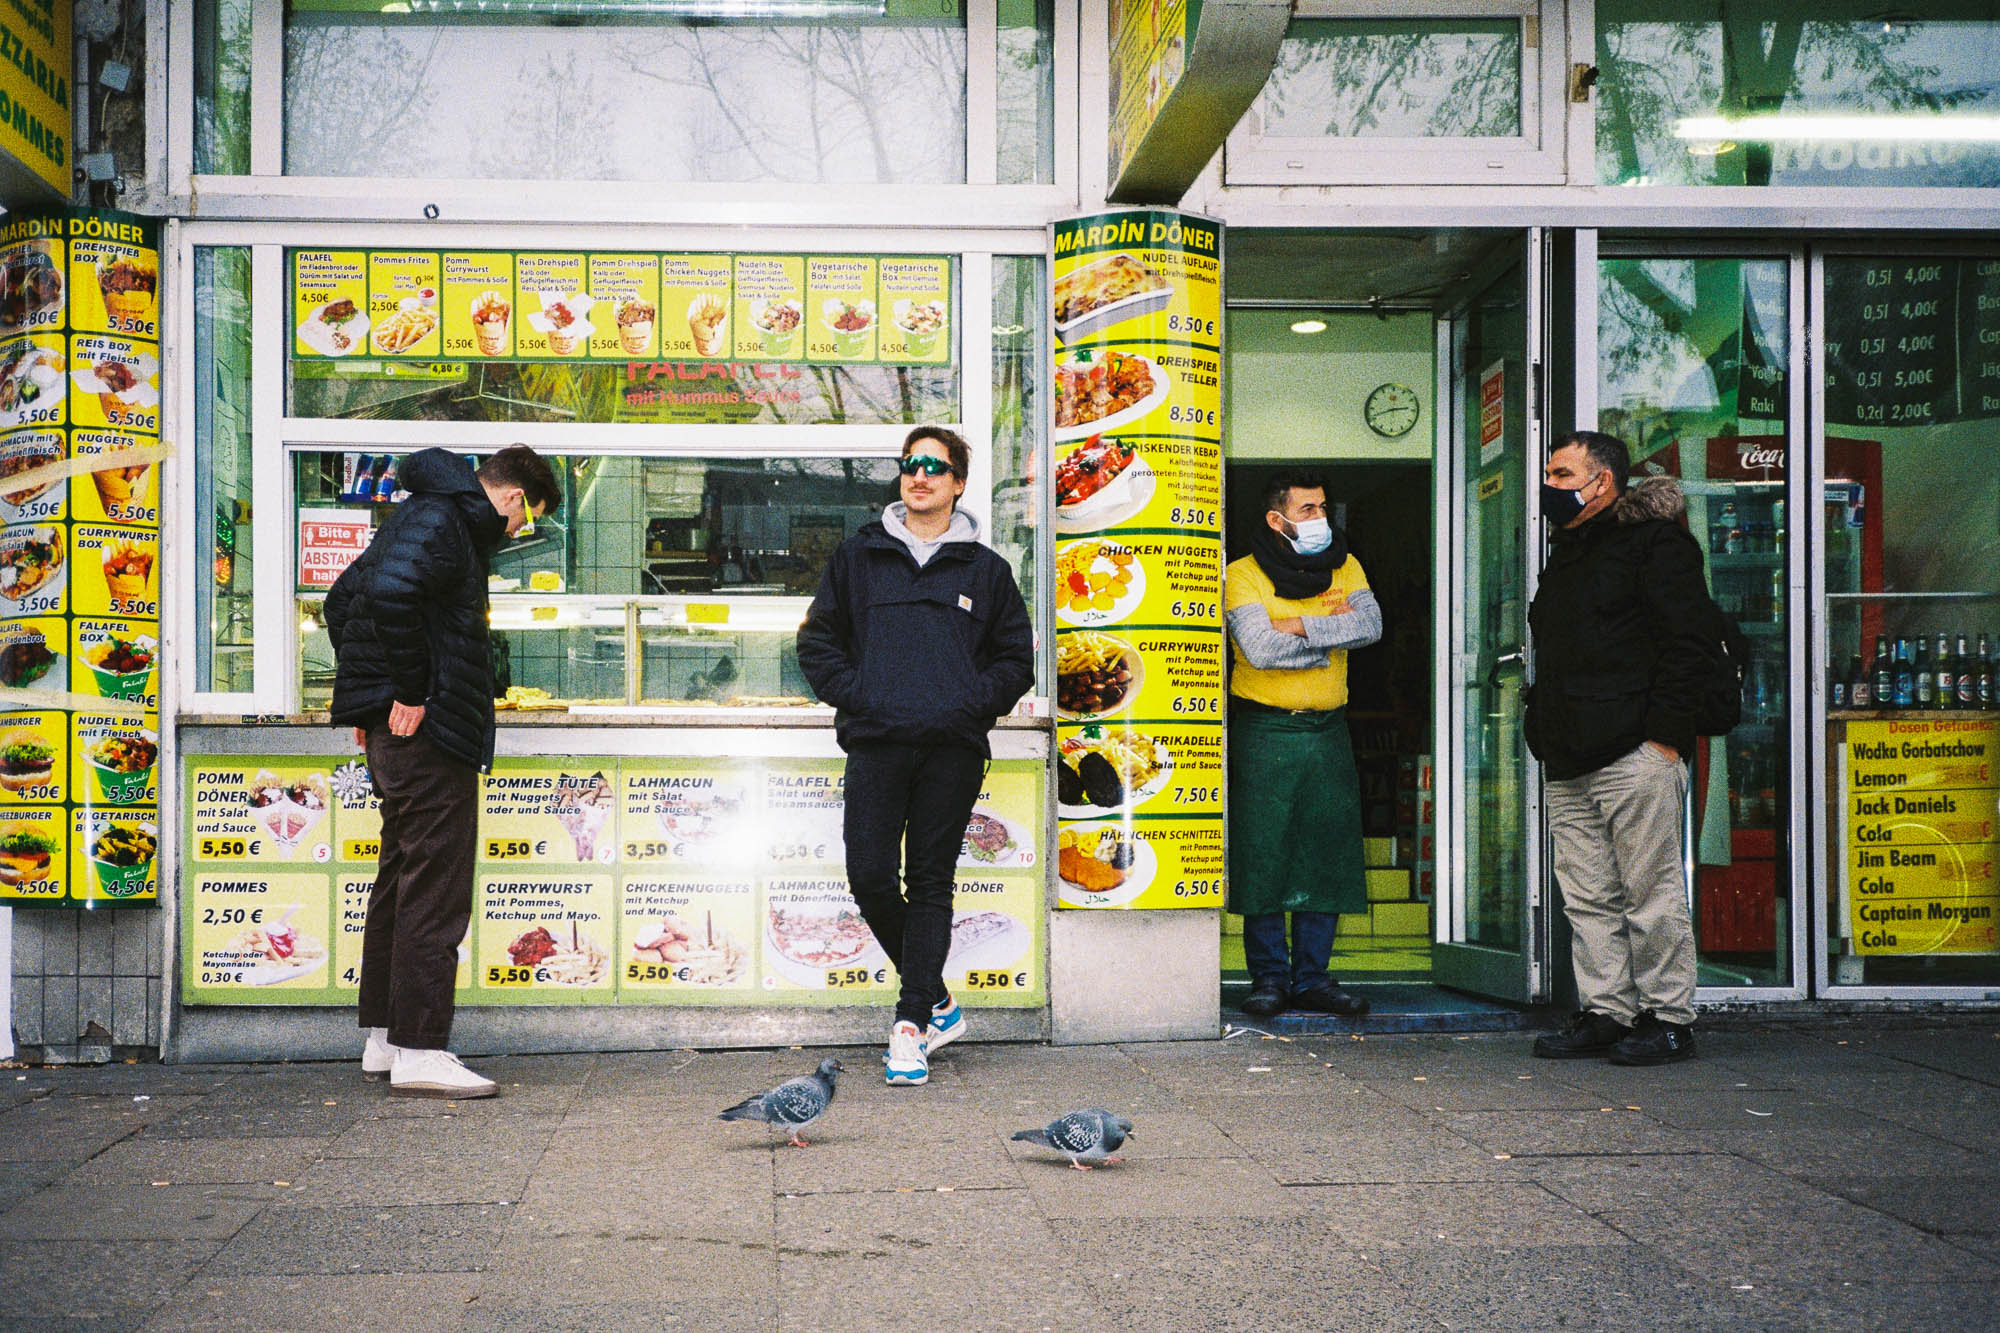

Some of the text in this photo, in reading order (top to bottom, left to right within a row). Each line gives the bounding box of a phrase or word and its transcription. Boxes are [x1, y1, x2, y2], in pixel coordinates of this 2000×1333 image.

[69, 216, 144, 245] DÖNER
[1151, 220, 1215, 251] DÖNER
[73, 253, 100, 265] BOX
[299, 253, 333, 262] FALAFEL
[373, 256, 430, 265] Pommes Frites
[445, 256, 470, 265] Pomm
[519, 258, 579, 268] Reis Drehspieß
[591, 259, 657, 269] Pomm Drehspieß
[665, 259, 690, 268] Pomm
[1142, 252, 1218, 272] NUDEL AUFLAUF
[445, 265, 489, 274] Currywurst
[738, 260, 783, 269] Nudeln Box
[811, 262, 868, 272] Vegetarische
[882, 263, 939, 273] Vegetarische
[664, 267, 730, 278] Chicken Nuggets
[811, 272, 828, 280] Box
[882, 273, 898, 281] Box
[1904, 265, 1942, 285] 4,00€
[299, 281, 337, 289] Sesamsauce
[301, 293, 329, 303] 4,50€
[371, 301, 399, 312] 2,50€
[1901, 300, 1939, 320] 4,00€
[107, 315, 155, 336] 5,50€
[1168, 314, 1203, 334] 8,50
[76, 338, 132, 353] REIS BOX
[446, 339, 473, 350] 5,50€
[519, 339, 547, 350] 5,50€
[591, 339, 619, 350] 5,50€
[664, 340, 691, 351] 5,50€
[737, 342, 765, 353] 5,50€
[811, 343, 838, 353] 4,50€
[881, 343, 908, 353] 4,50€
[1898, 334, 1936, 354] 4,00€
[76, 351, 141, 367] mit Fleisch
[1180, 371, 1218, 388] TELLER
[1895, 368, 1934, 388] 5,00€
[627, 391, 655, 406] mit
[1751, 397, 1775, 413] Raki
[18, 408, 59, 427] 5,50€
[1169, 406, 1203, 425] 8,50
[1891, 402, 1932, 421] 2,00€
[107, 410, 156, 430] 5,50€
[77, 433, 134, 448] NUGGETS
[77, 445, 102, 455] BOX
[1139, 442, 1218, 460] ISKENDER KEBAP
[18, 502, 59, 518] 5,50€
[108, 503, 156, 522] 5,50€
[1170, 507, 1204, 525] 8,50
[77, 527, 157, 543] CURRYWURST
[318, 527, 351, 539] Bitte
[77, 539, 103, 550] BOX
[1098, 545, 1218, 559] CHICKEN NUGGETS
[1183, 559, 1218, 572] Pommes,
[1166, 571, 1203, 582] Ketchup
[1170, 583, 1218, 594] Mayonnaise
[18, 596, 59, 612] 3,50€
[108, 598, 156, 615] 5,50€
[1171, 601, 1206, 618] 6,50
[79, 621, 130, 633] FALAFEL
[79, 632, 104, 643] BOX
[1138, 641, 1220, 655] CURRYWURST
[1184, 655, 1220, 668] Pommes,
[1167, 667, 1204, 678] Ketchup
[1171, 679, 1220, 689] Mayonnaise
[1172, 697, 1206, 714] 6,50
[78, 716, 144, 728] NUDEL BOX
[1889, 721, 1930, 734] Dosen
[78, 728, 141, 739] mit Fleisch
[1152, 736, 1222, 747] FRIKADELLE
[1186, 750, 1222, 760] Pommes,
[1853, 739, 1985, 760] Wodka Gorbatschow
[1199, 761, 1222, 770] Sauce
[197, 772, 244, 785] POMM
[486, 775, 598, 789] POMMES TÜTE
[628, 777, 713, 789] LAHMACUN
[768, 776, 832, 788] FALAFEL
[1854, 769, 1907, 787] Lemon
[17, 785, 59, 800] 4,50€
[108, 785, 155, 801] 5,50€
[197, 788, 248, 803] DÖNER
[510, 792, 560, 804] Nuggets
[651, 791, 683, 801] Salat
[1174, 787, 1207, 805] 7,50
[486, 805, 581, 815] oder Sauce
[1855, 795, 1956, 816] Jack Daniels
[196, 807, 249, 818] mit Salat
[221, 822, 257, 833] Sauce
[1857, 824, 1892, 842] Cola
[1169, 829, 1222, 841] SCHNITTZEL
[201, 841, 245, 857] 5,50
[353, 844, 379, 857] 5,50
[488, 842, 530, 857] 5,50
[626, 842, 668, 859] 3,50
[1180, 855, 1212, 865] Ketchup
[1857, 849, 1937, 868] Jim Beam
[1183, 866, 1223, 876] Mayonnaise
[16, 879, 59, 895] 4,50€
[108, 879, 155, 895] 4,50€
[201, 882, 268, 893] POMMES
[486, 883, 593, 894] CURRYWURST
[625, 883, 750, 894] CHICKENNUGGETS
[769, 880, 846, 891] LAHMACUN
[961, 881, 1004, 894] DÖNER
[1175, 880, 1208, 898] 6,50
[1859, 876, 1894, 894] Cola
[509, 898, 565, 910] Pommes,
[645, 896, 689, 907] Ketchup
[202, 908, 246, 925] 2,50
[485, 911, 601, 923] Ketchup Mayo.
[1860, 903, 1991, 925] Captain Morgan
[1862, 930, 1897, 947] Cola
[202, 951, 242, 960] Ketchup
[202, 960, 256, 969] Mayonnaise
[201, 972, 232, 985] 0,30
[488, 968, 531, 983] 5,50
[627, 965, 669, 981] 5,50
[827, 970, 868, 987] 5,50
[968, 972, 1009, 988] 5,50
